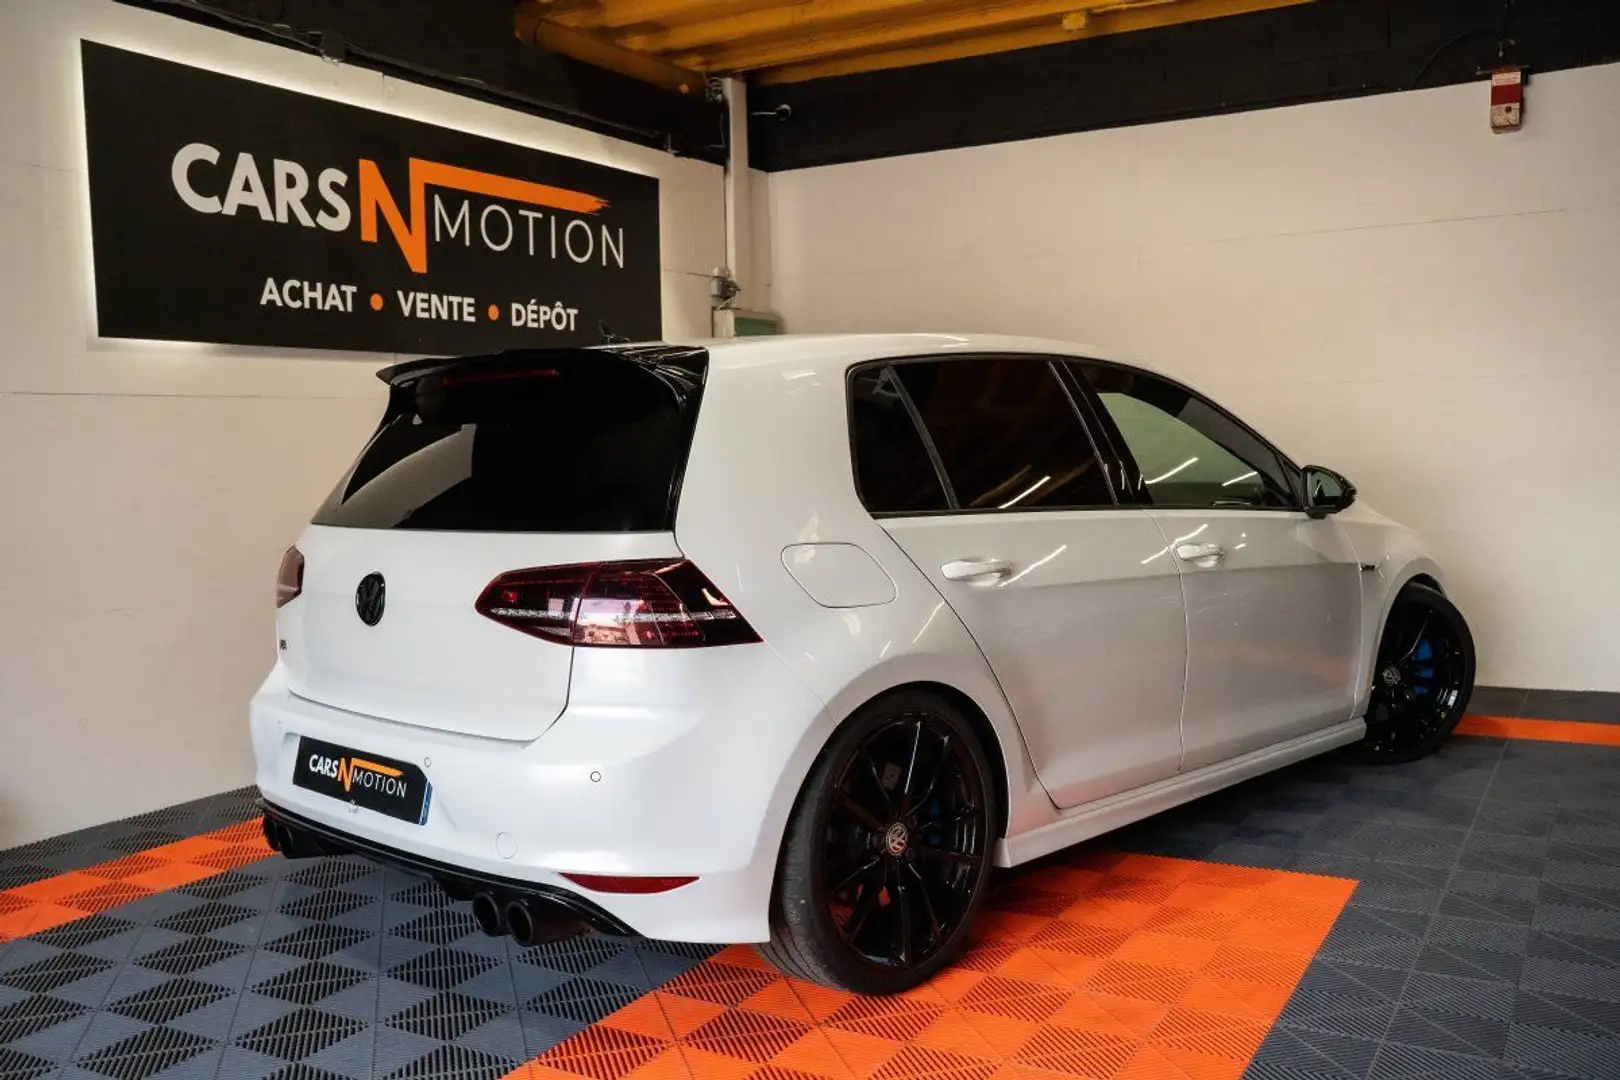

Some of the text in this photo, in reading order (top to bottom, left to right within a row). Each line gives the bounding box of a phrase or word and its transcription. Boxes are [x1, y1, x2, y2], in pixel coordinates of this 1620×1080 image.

[259, 277, 579, 332] ACHAT VENTE DÉPÔT
